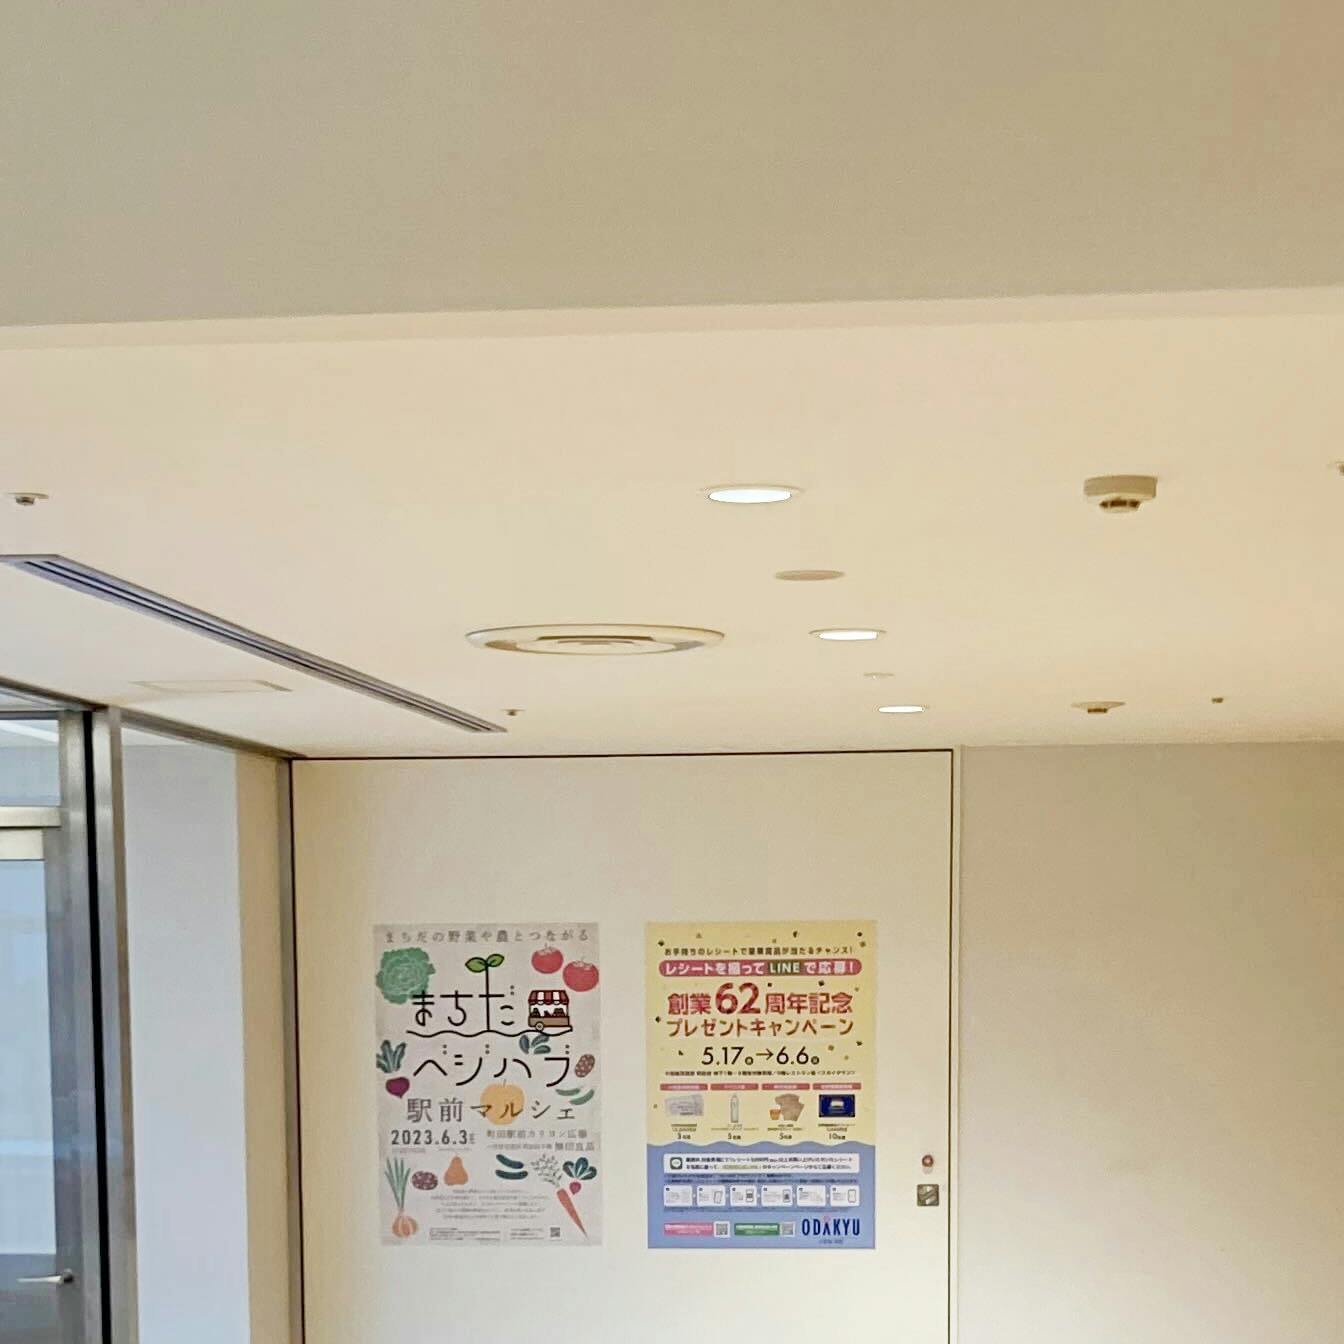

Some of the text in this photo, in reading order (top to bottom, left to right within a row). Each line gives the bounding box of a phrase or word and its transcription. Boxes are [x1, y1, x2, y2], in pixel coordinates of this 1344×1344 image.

[769, 961, 800, 974] LINE
[412, 983, 516, 1032] まちだ
[666, 982, 854, 1015] 創業62周年記念
[665, 1018, 854, 1038] プレゼントキャンペーン
[413, 1043, 571, 1087] ベジハブ
[406, 1097, 577, 1124] 駅前マルシェ
[801, 1217, 861, 1237] ODAKYU
